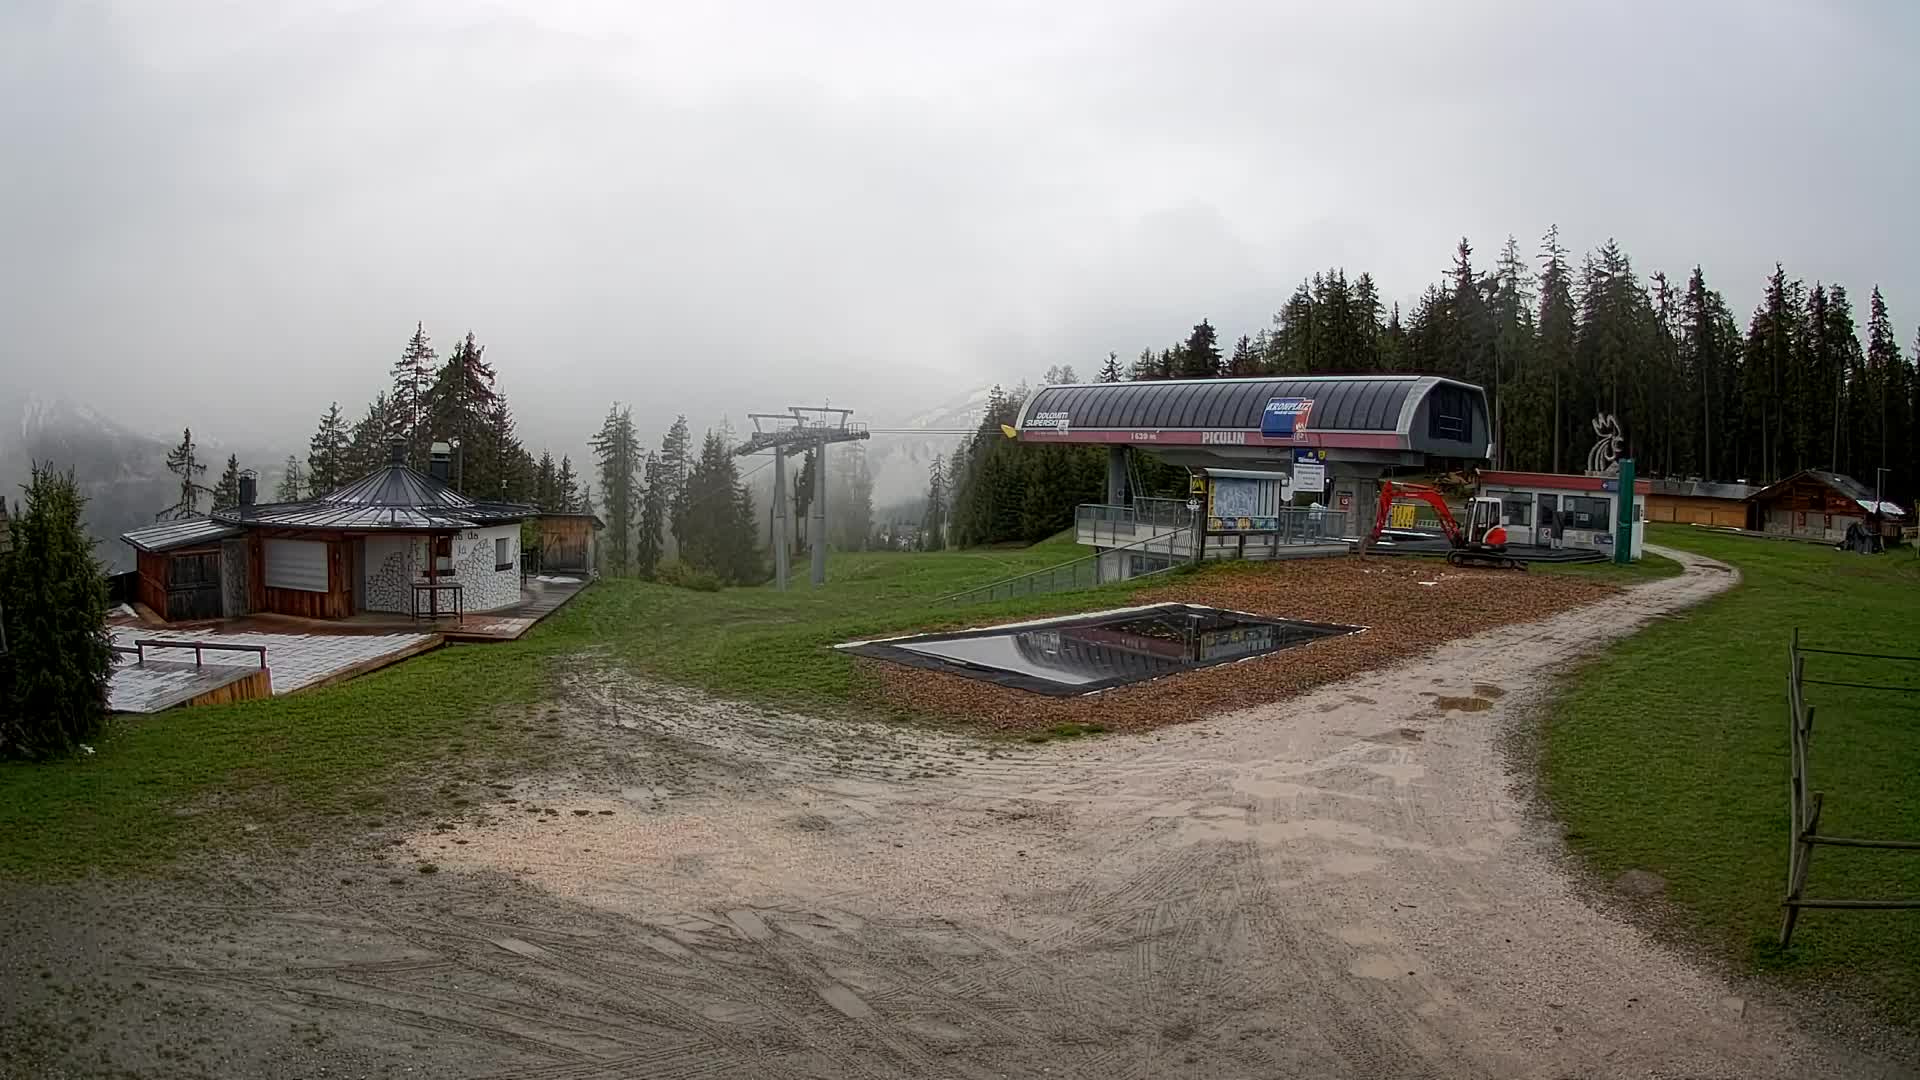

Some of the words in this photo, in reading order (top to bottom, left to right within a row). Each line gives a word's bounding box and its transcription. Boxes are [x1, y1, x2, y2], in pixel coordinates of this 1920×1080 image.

[1266, 402, 1312, 411] KRONPLATZ
[1036, 411, 1069, 419] DOLOMITI
[1025, 419, 1059, 427] SUPERSKI
[1202, 432, 1245, 445] PICULIN
